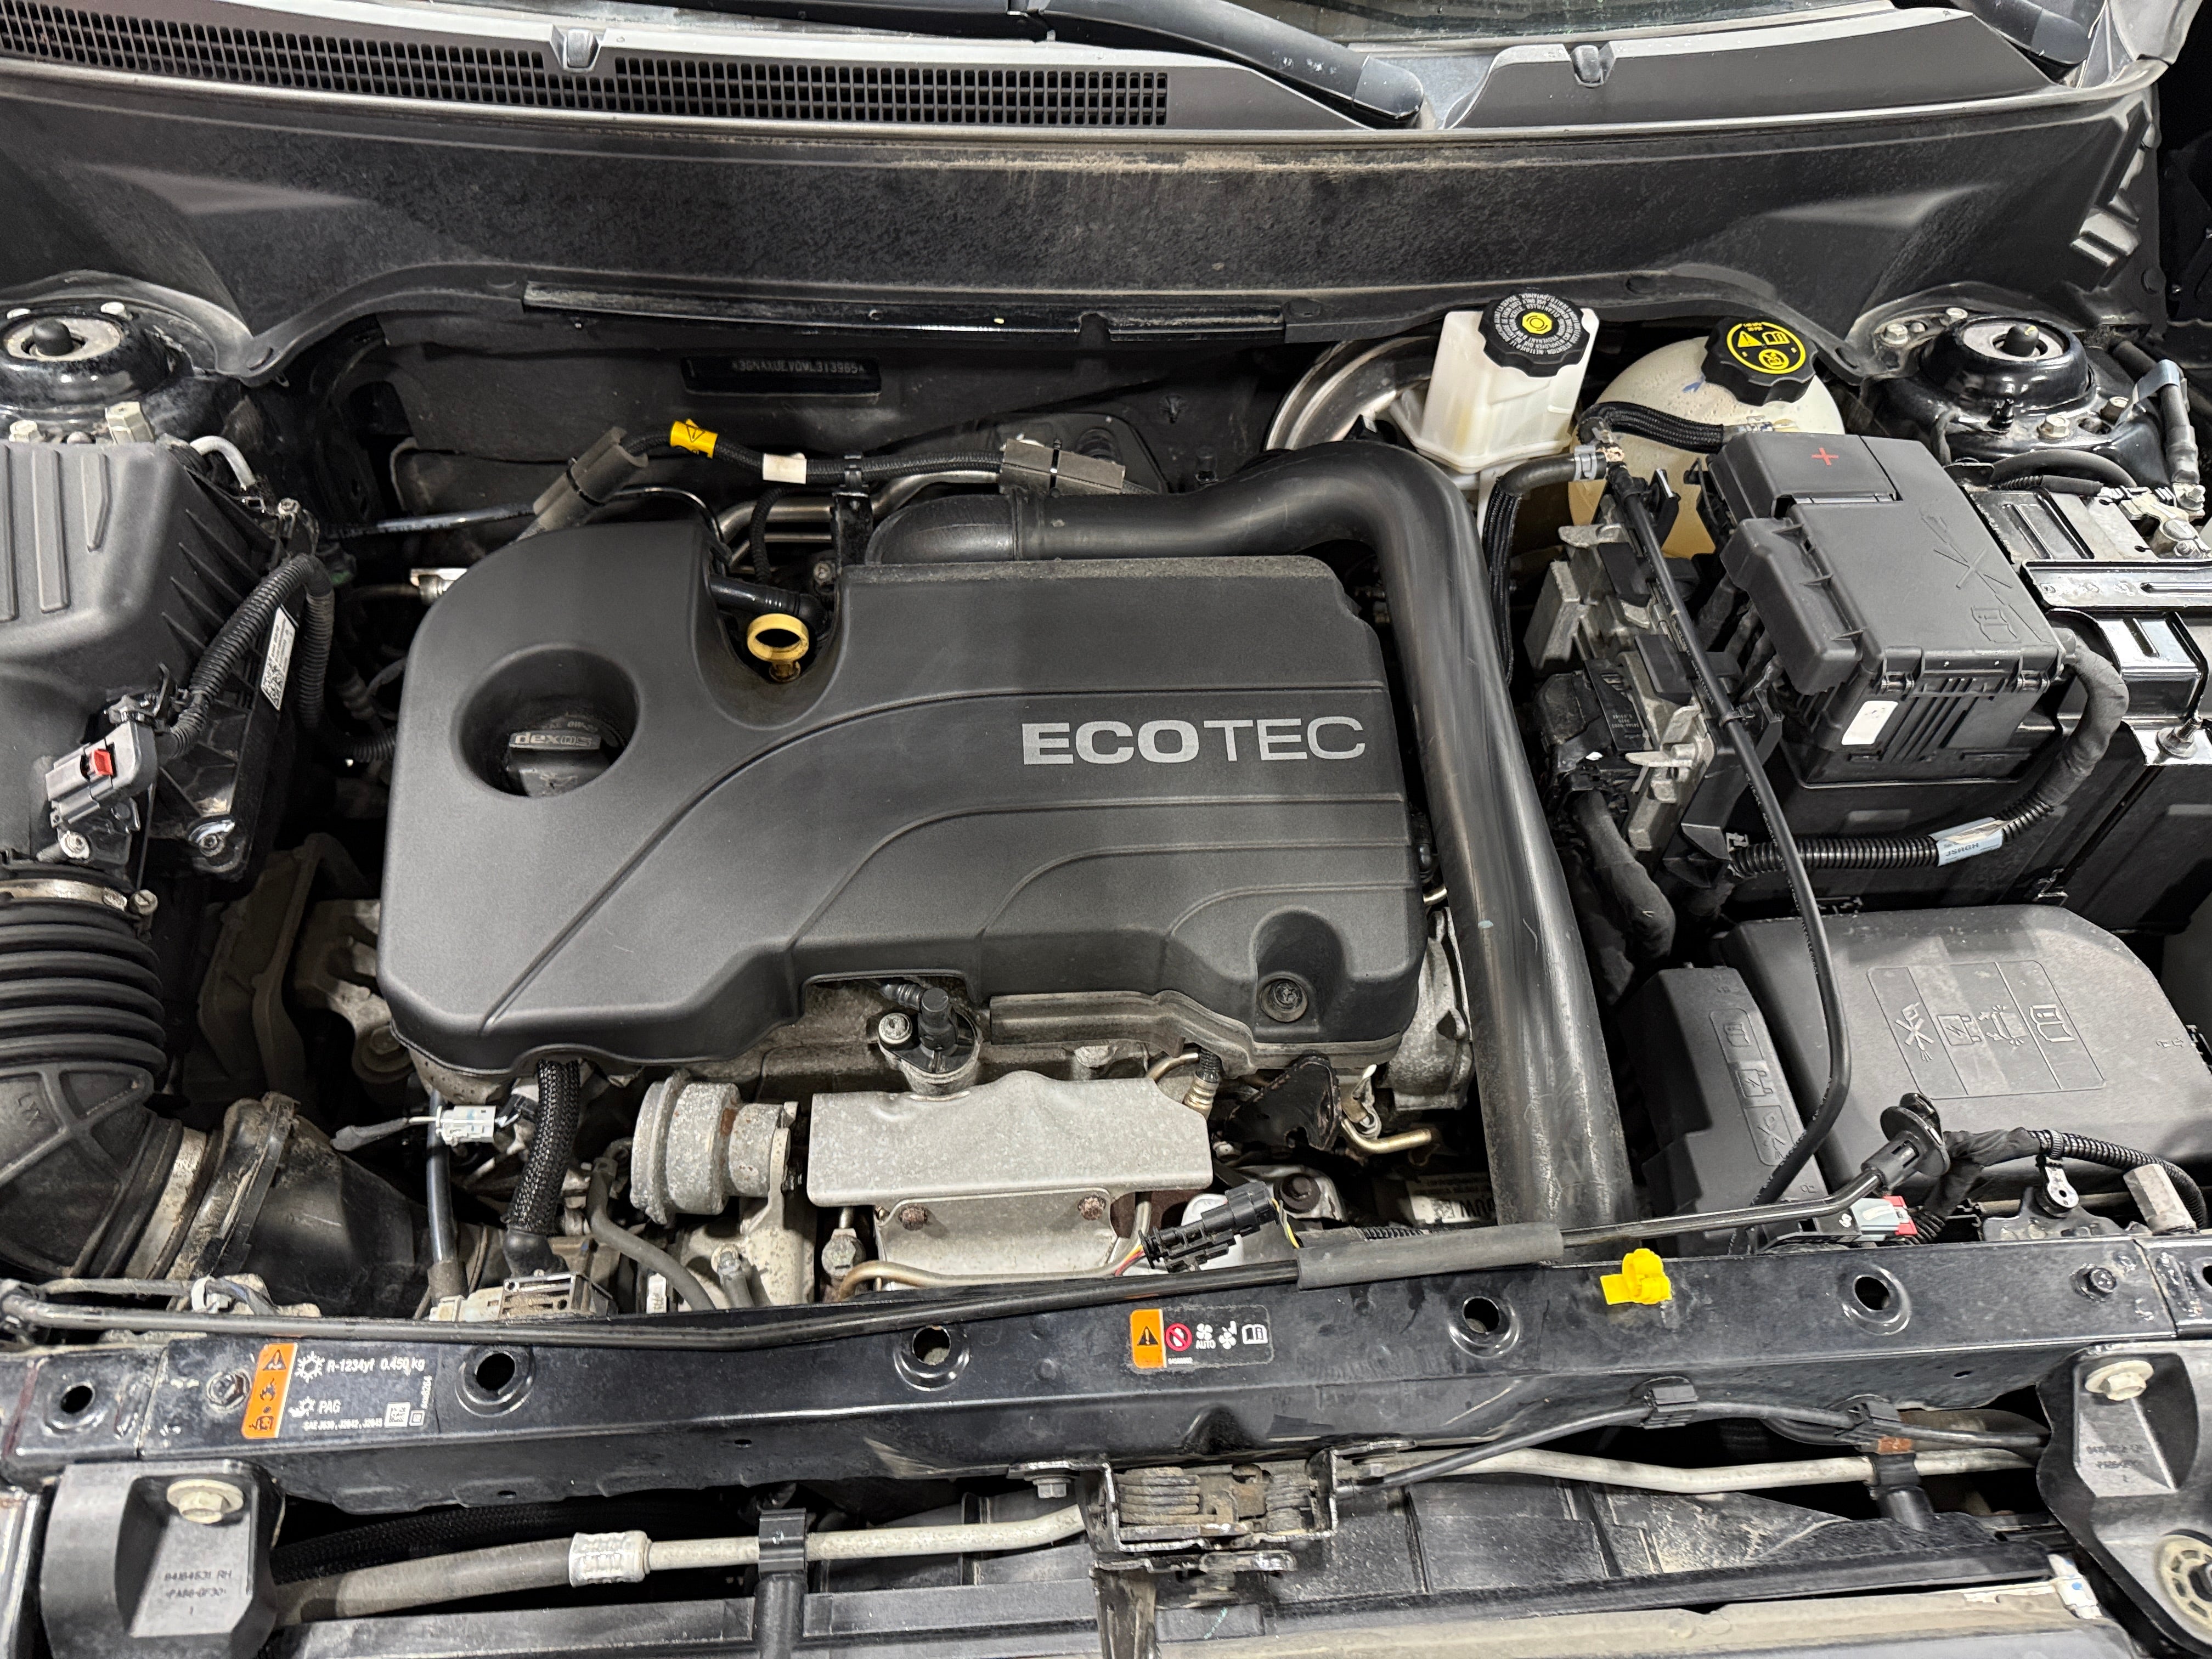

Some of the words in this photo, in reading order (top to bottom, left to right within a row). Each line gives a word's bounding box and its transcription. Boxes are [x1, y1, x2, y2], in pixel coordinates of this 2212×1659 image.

[515, 732, 592, 747] dexos
[1022, 716, 1365, 765] ECOTEC
[1945, 843, 1979, 856] JSRGH
[1195, 1340, 1216, 1350] AUTO
[326, 1358, 375, 1374] R-1234yf
[380, 1356, 411, 1372] 0.450
[411, 1357, 425, 1372] kg
[318, 1400, 341, 1414] PAG
[302, 1421, 318, 1431] SAE
[217, 1570, 232, 1579] RH
